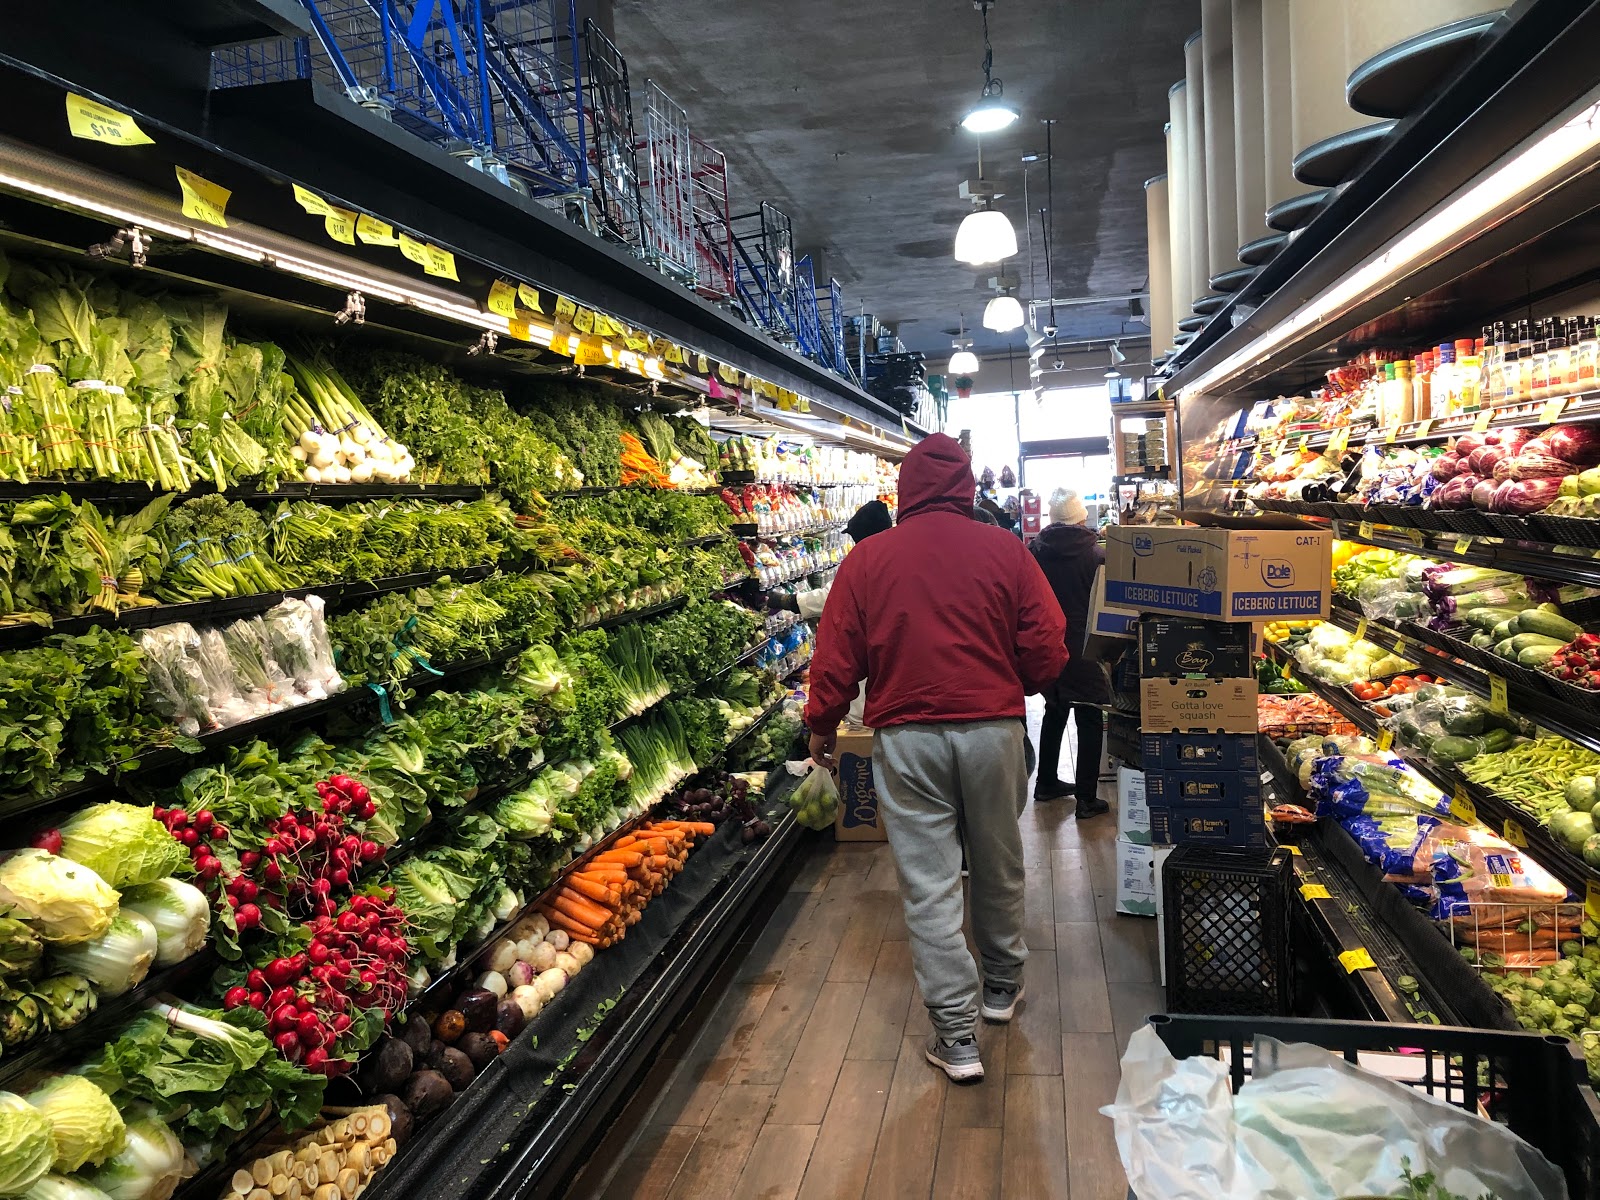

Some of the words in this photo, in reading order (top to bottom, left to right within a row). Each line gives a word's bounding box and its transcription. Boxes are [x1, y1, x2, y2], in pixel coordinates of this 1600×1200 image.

[1136, 537, 1152, 548] Dole
[1296, 536, 1320, 546] CAT-I
[1267, 564, 1291, 578] Dole
[1124, 586, 1160, 603] ICEBERG
[1161, 591, 1199, 608] LETTUCE
[1234, 597, 1276, 611] ICEBERG
[1278, 596, 1318, 609] LETTUCE
[1181, 651, 1208, 672] Bay
[1171, 701, 1200, 710] Gotta
[1202, 701, 1224, 710] love
[1179, 711, 1216, 721] squash
[853, 759, 877, 822] Organic
